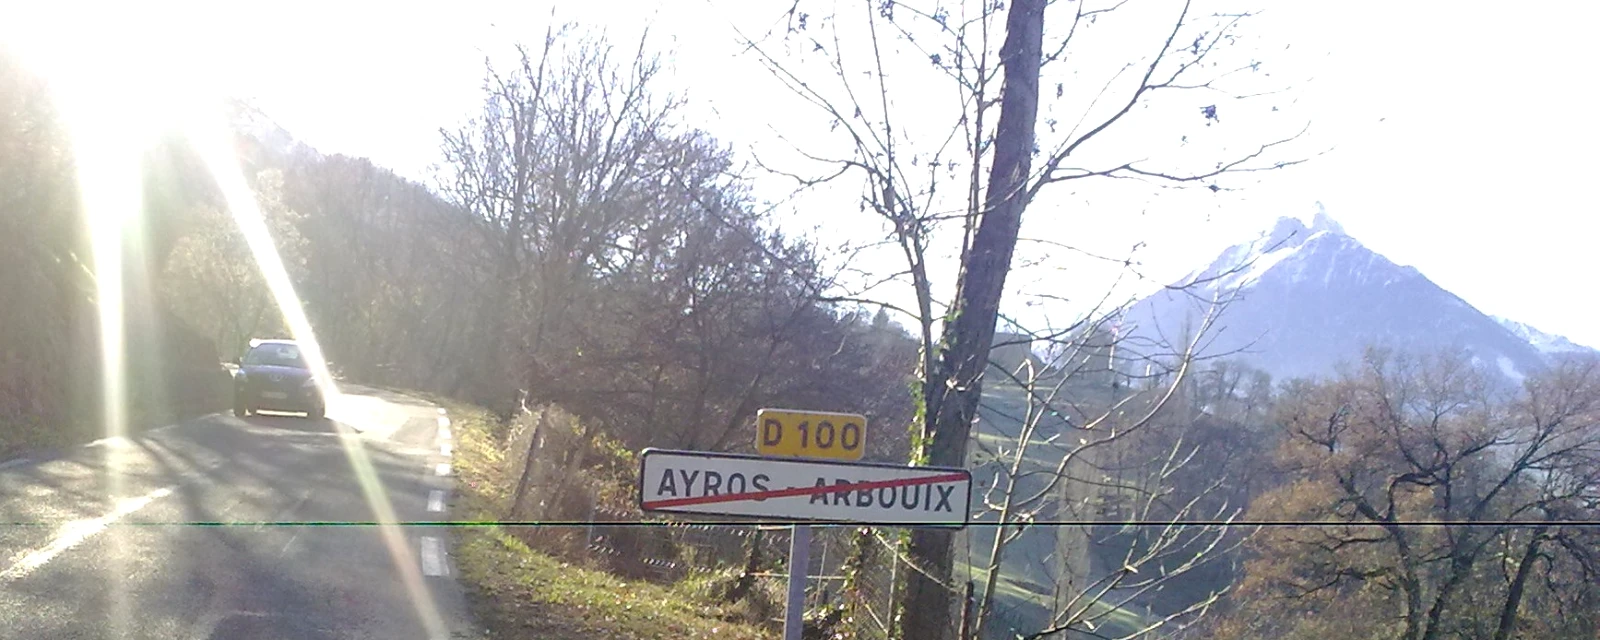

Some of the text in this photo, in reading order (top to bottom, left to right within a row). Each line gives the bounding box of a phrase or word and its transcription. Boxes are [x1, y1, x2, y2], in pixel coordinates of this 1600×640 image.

[763, 419, 861, 450] D 100
[656, 468, 771, 501] AYROS
[809, 477, 955, 512] ARBOUIX
